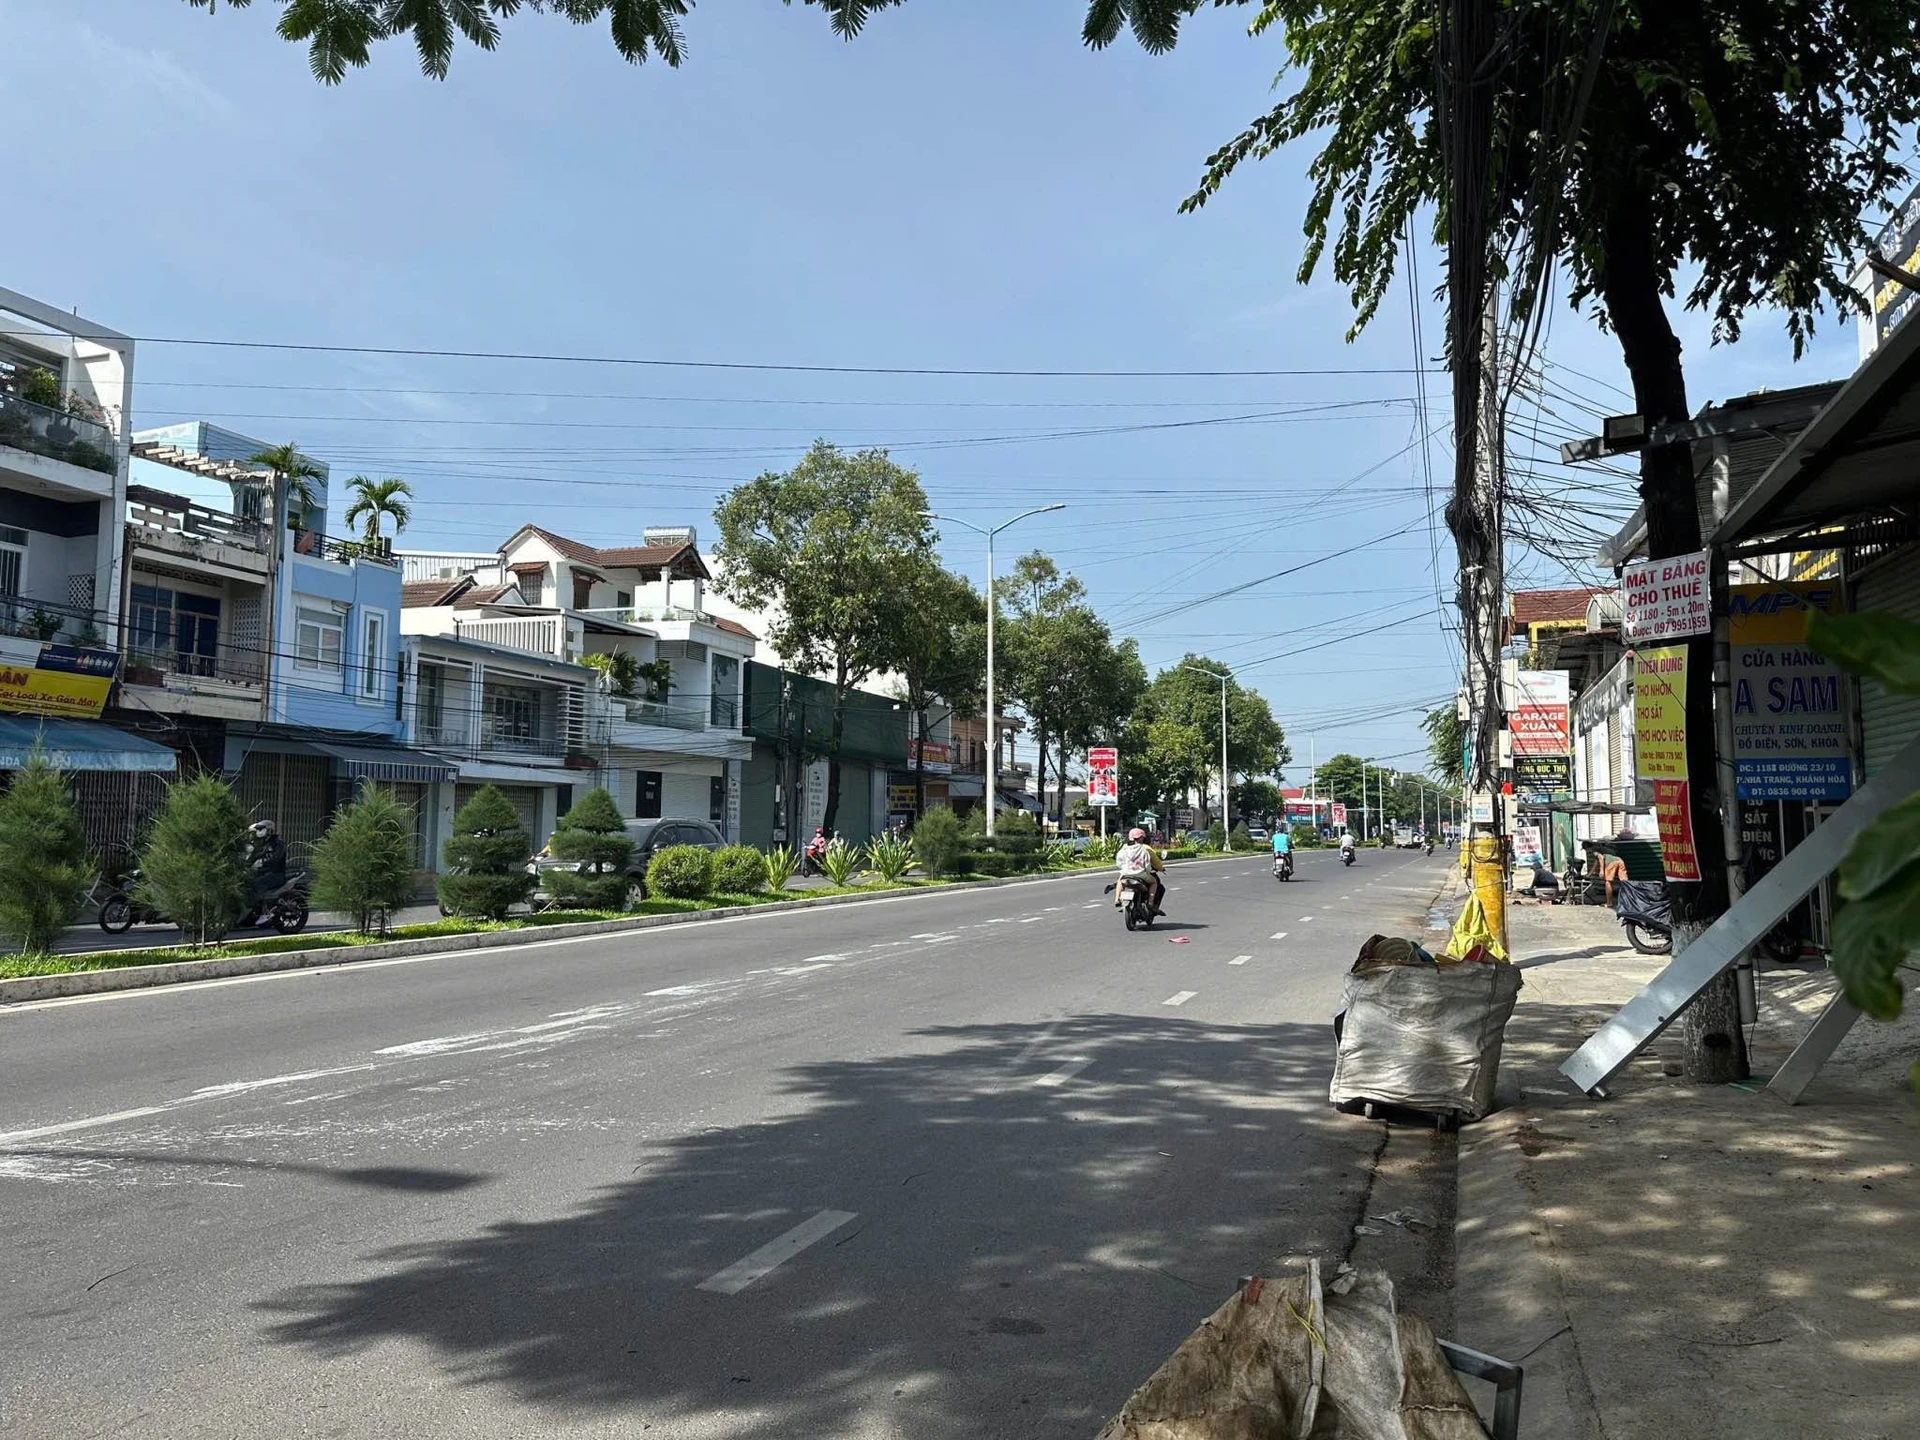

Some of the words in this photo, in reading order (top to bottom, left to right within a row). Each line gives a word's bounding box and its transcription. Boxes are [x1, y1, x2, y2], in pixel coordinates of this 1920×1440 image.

[1626, 569, 1658, 590] MẶT
[1662, 559, 1707, 582] BẰNG
[1628, 590, 1658, 608] CHO
[1662, 577, 1702, 602] THUÊ
[1626, 610, 1636, 623] Số
[1638, 607, 1659, 621] 1180
[1667, 605, 1679, 617] 5m
[1660, 657, 1683, 675] DỤNG
[1742, 648, 1775, 667] CỬA
[1734, 677, 1755, 715] A
[1766, 675, 1838, 714] SAM
[1512, 712, 1566, 721] GARAGE
[1520, 719, 1558, 731] XUÂN
[1779, 724, 1804, 735] KINH
[1809, 787, 1826, 796] 404
[1744, 807, 1769, 824] SẮT
[1742, 829, 1772, 845] ĐIỆN
